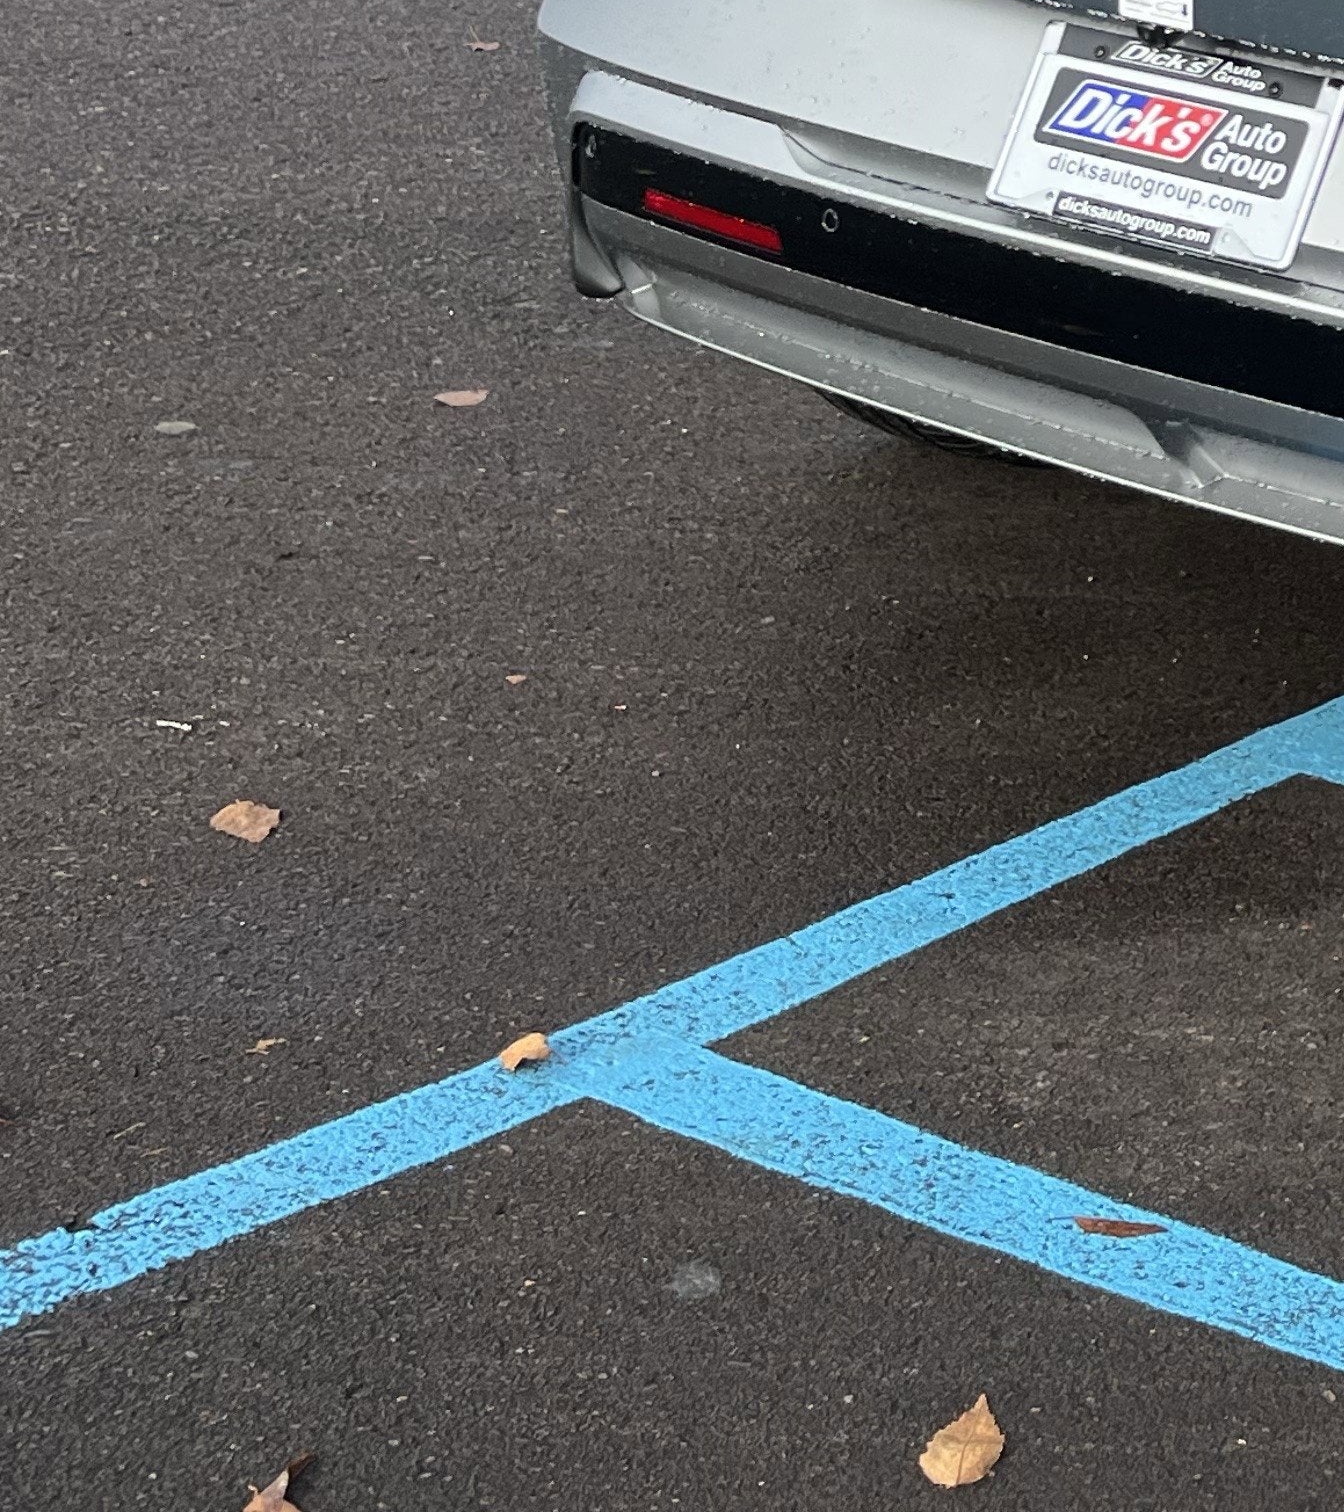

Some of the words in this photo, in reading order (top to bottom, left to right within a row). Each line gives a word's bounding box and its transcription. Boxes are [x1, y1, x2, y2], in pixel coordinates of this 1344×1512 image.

[1119, 43, 1209, 75] Dick's
[1211, 70, 1266, 92] Group
[1220, 61, 1262, 80] Auto
[1057, 87, 1202, 153] Dick's
[1214, 114, 1287, 154] Auto
[1048, 152, 1254, 218] dicksautogroup.com
[1201, 141, 1288, 190] Group
[1057, 195, 1212, 245] dicksautogroup.com
